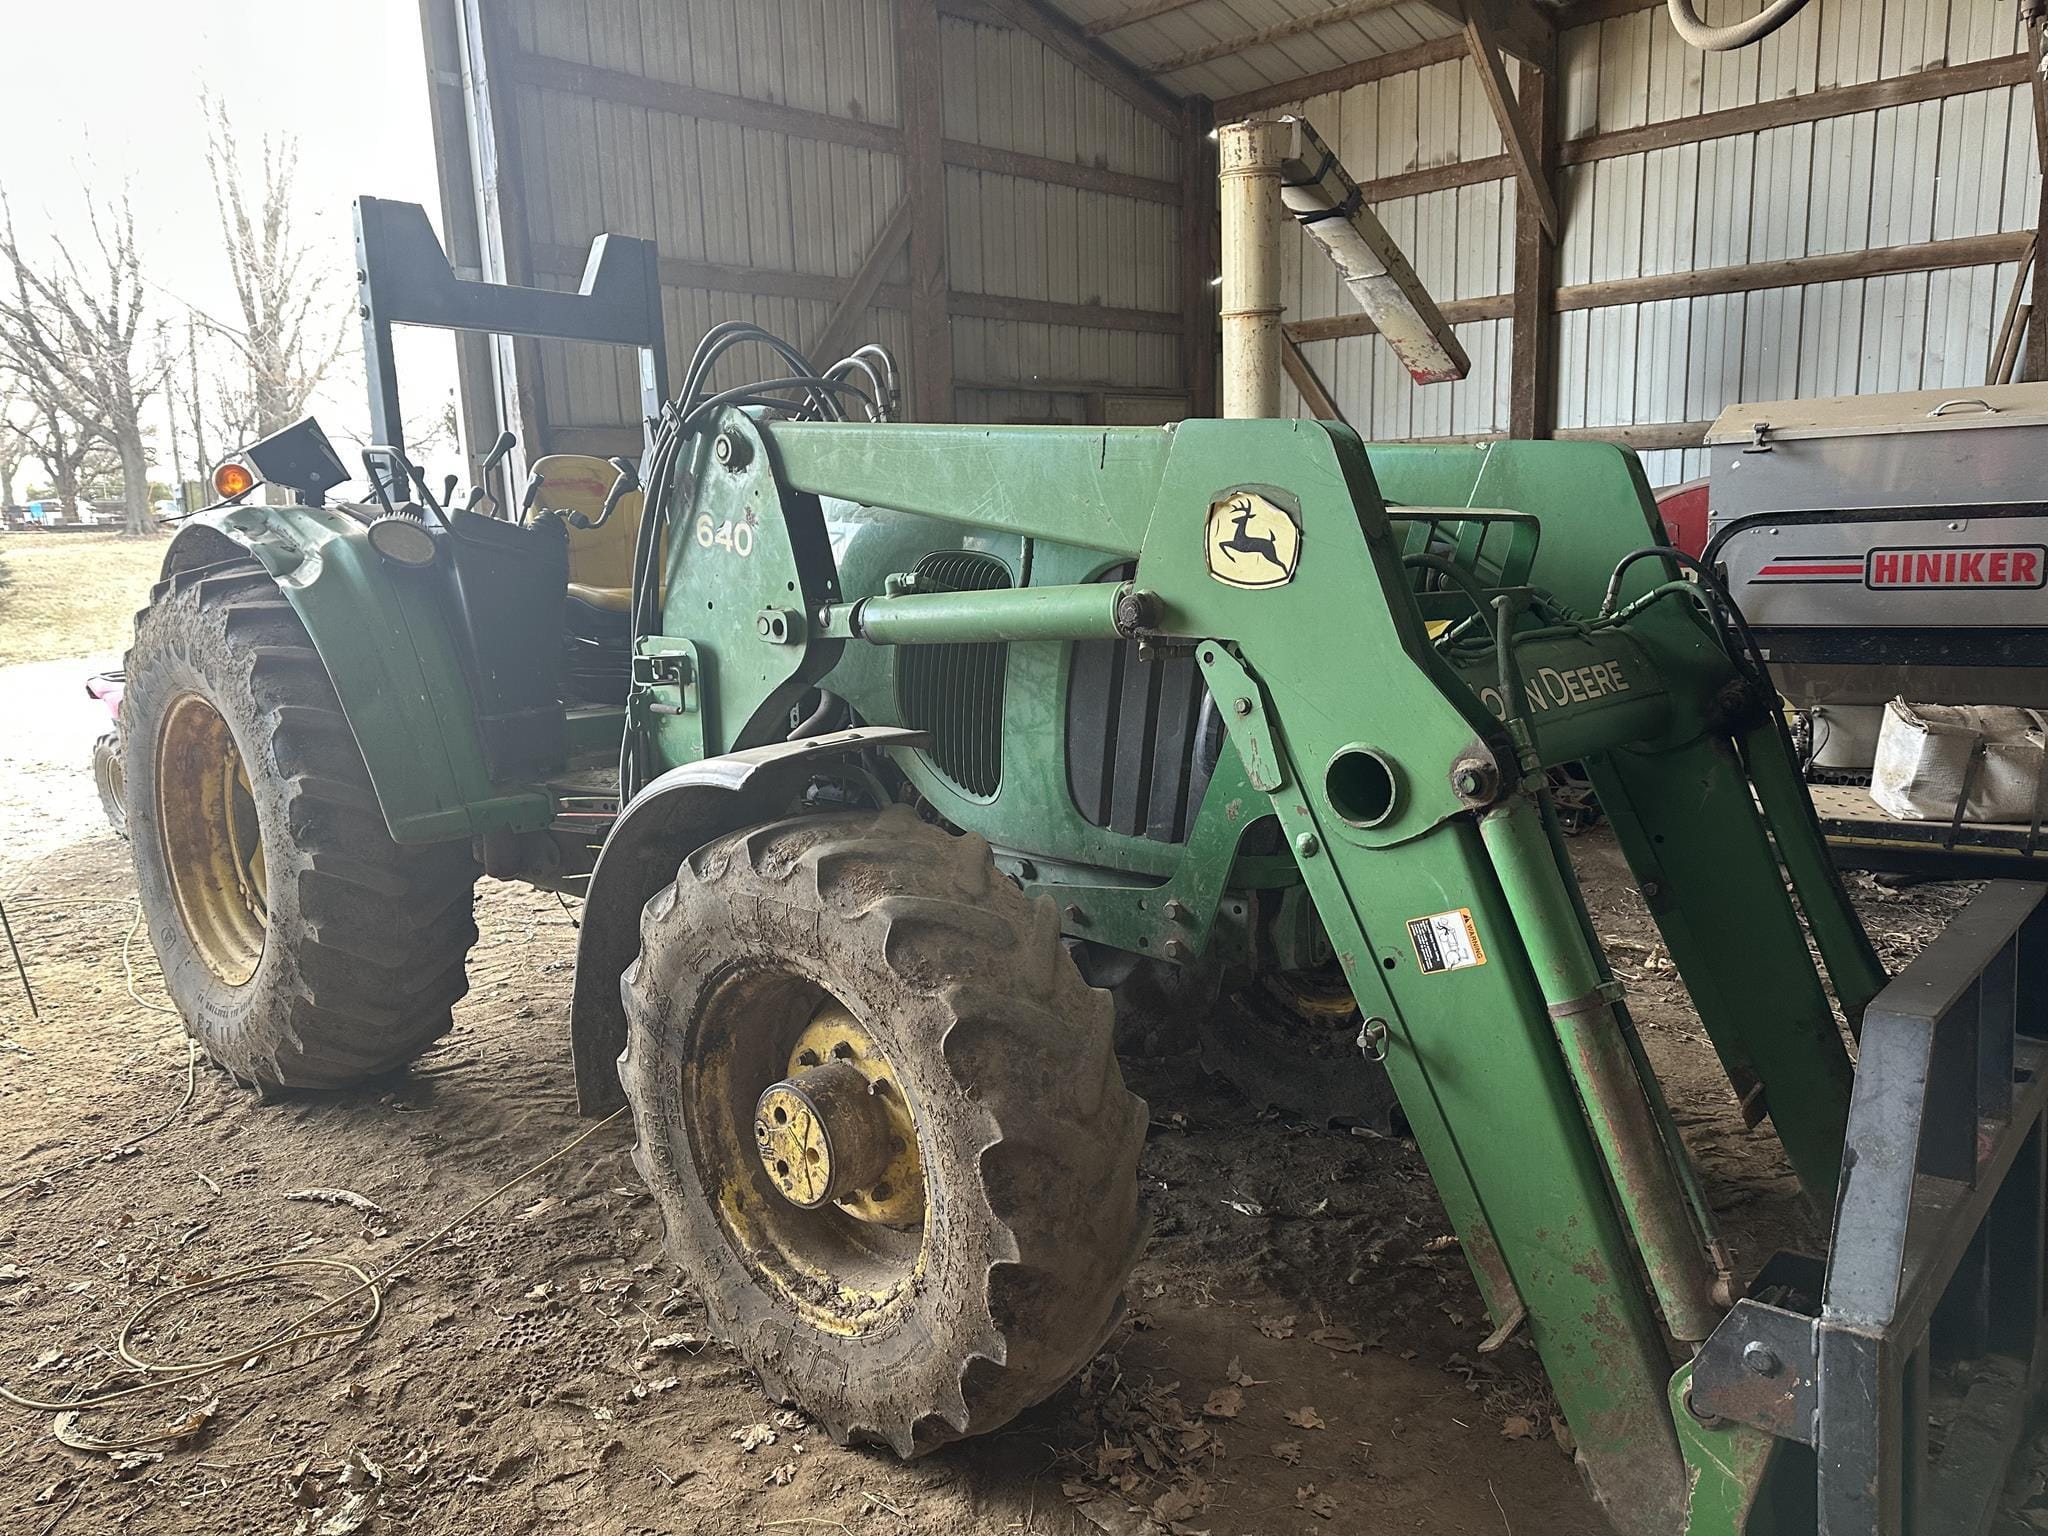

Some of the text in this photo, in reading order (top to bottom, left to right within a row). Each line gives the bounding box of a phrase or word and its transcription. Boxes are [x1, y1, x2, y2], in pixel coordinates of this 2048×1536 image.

[696, 511, 753, 558] 640
[1873, 551, 2038, 584] HINIKER
[1537, 660, 1631, 707] DEERE
[1466, 923, 1484, 960] WARNING
